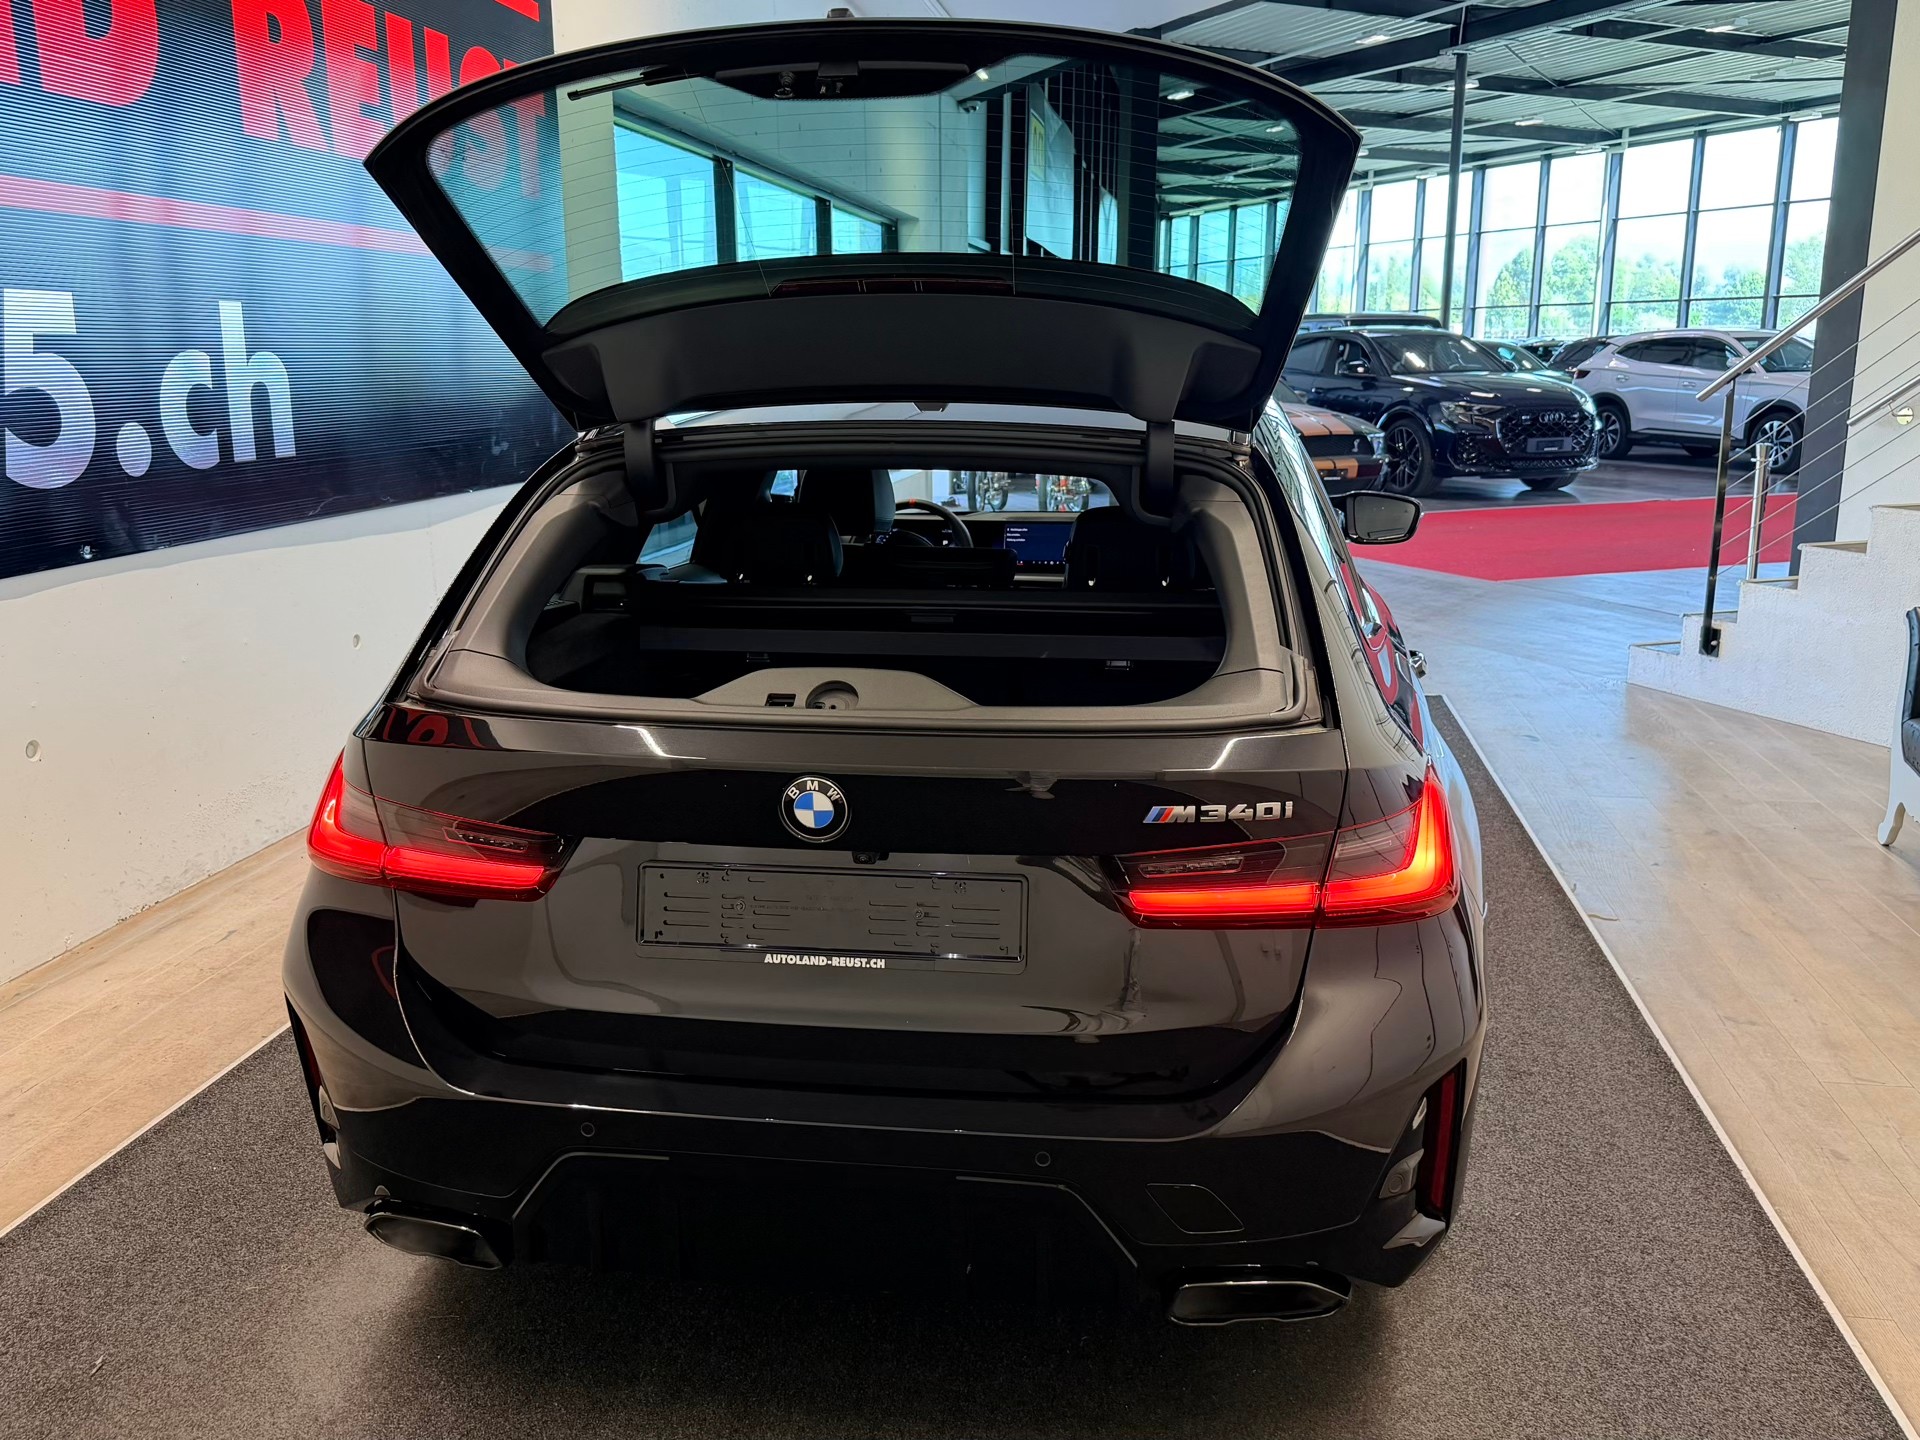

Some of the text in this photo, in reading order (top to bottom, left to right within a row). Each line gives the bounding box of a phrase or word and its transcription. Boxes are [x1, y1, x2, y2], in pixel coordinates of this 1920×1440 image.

[231, 0, 546, 200] REUST
[3, 288, 297, 489] 5.ch
[787, 780, 841, 801] BMW
[1160, 801, 1293, 823] M340i
[764, 953, 886, 969] AUTOLAND-REUST.CH
